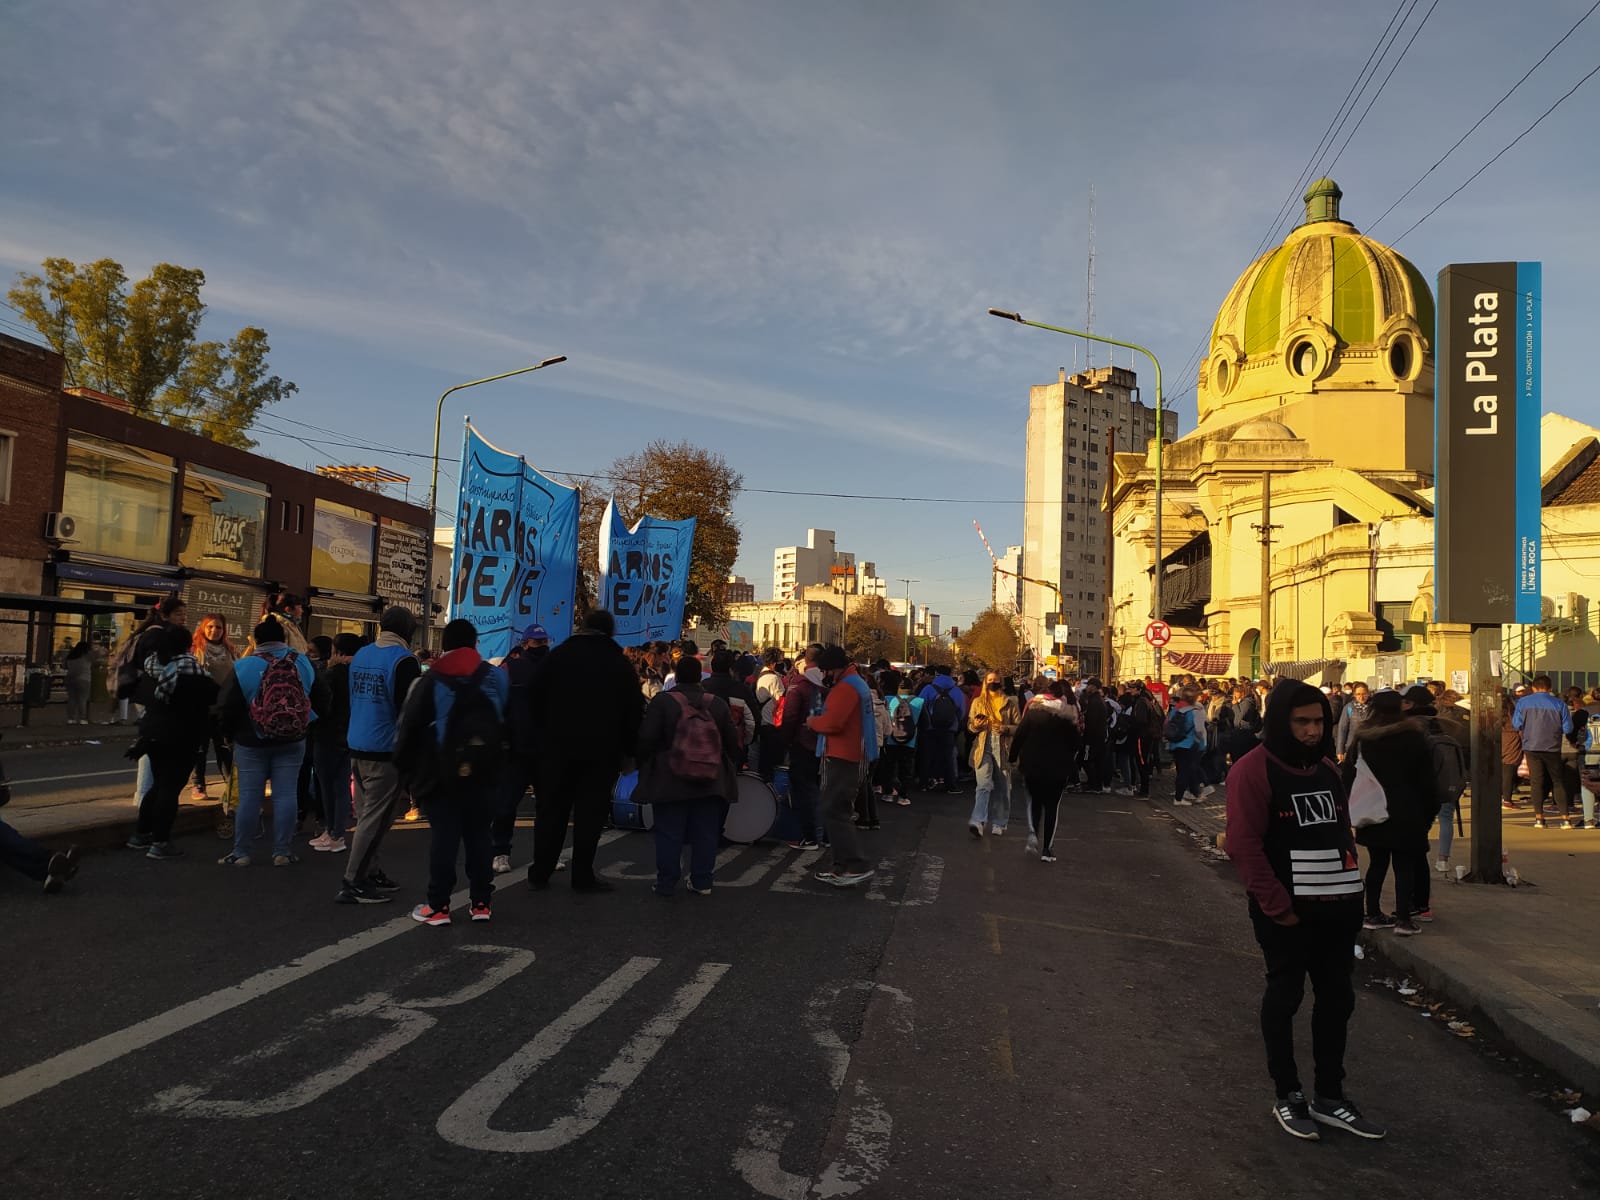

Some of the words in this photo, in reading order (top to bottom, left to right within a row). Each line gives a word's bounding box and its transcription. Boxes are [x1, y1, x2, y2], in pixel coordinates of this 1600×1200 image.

[1526, 312, 1533, 321] LA
[1466, 292, 1499, 382] Plata
[1466, 395, 1498, 435] La
[1528, 540, 1536, 564] ROCA
[1527, 566, 1536, 591] LÍNEA
